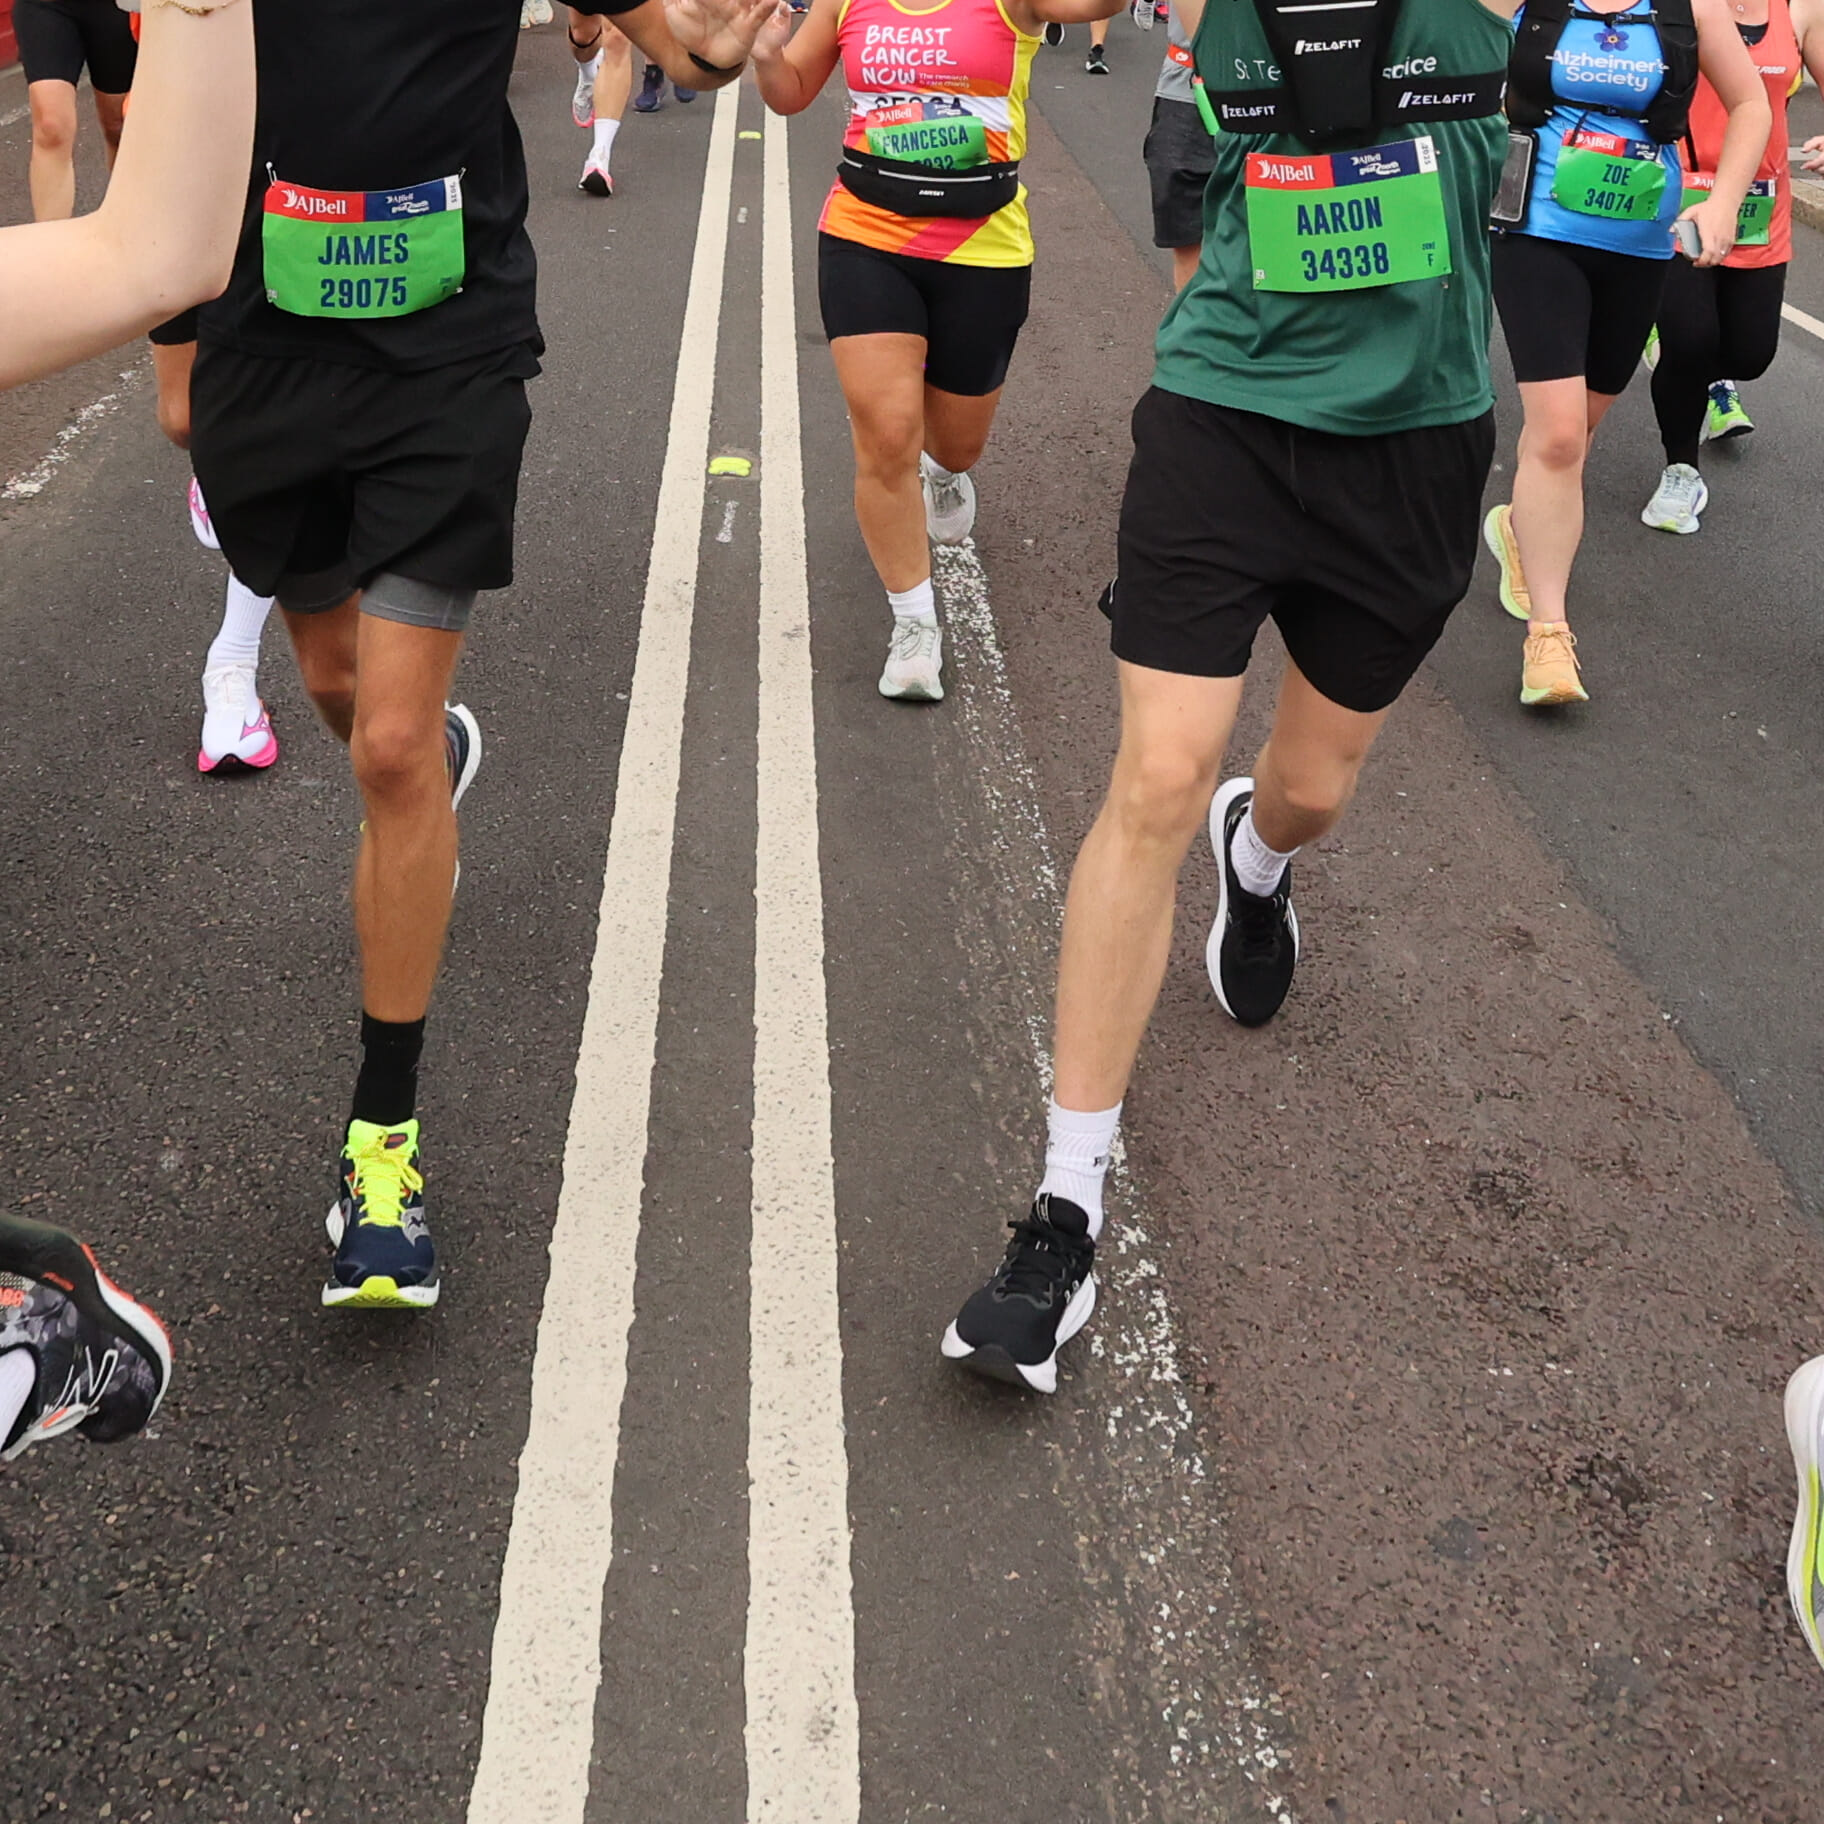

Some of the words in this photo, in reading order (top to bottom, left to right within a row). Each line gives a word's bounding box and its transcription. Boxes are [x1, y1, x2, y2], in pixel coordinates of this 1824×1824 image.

[865, 25, 952, 46] BREAST
[861, 46, 957, 66] CANCER
[862, 67, 915, 85] NOW
[1565, 65, 1648, 92] Society
[883, 125, 969, 154] FRANCESCA
[1271, 163, 1314, 184] AJBell
[1602, 163, 1632, 186] ZOE
[295, 197, 346, 215] AJBell
[1585, 188, 1634, 213] 34074
[1297, 196, 1383, 236] AARON
[318, 233, 409, 266] JAMES
[1301, 242, 1390, 281] 34338
[320, 277, 407, 309] 29075
